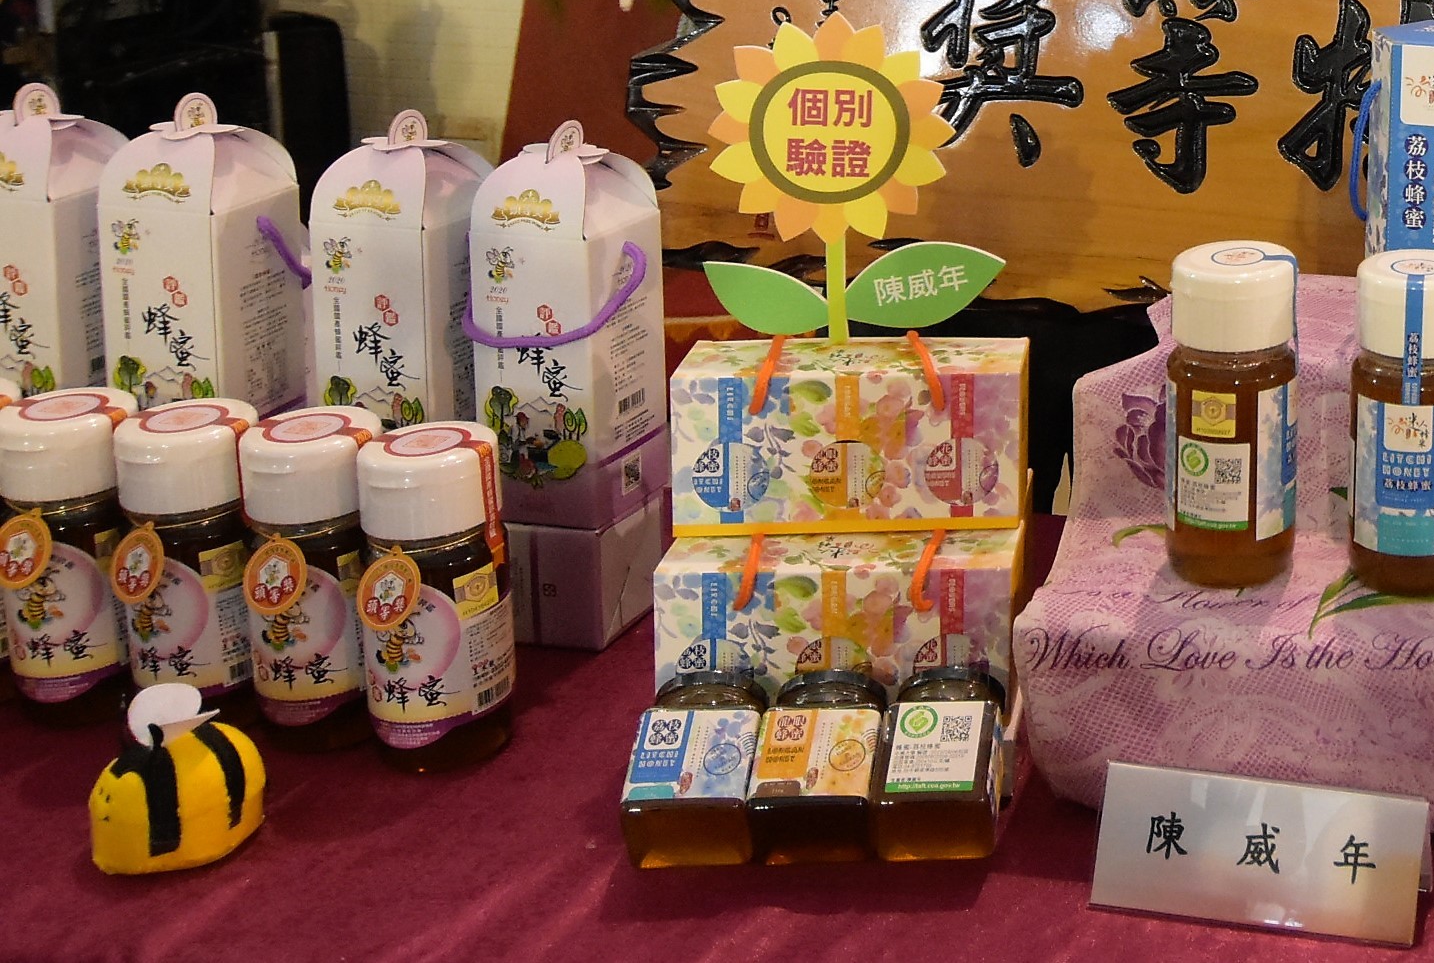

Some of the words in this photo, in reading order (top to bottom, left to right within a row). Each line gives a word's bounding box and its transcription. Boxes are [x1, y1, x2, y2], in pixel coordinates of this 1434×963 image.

[787, 88, 873, 128] 個別
[786, 138, 872, 178] 驗證
[1403, 133, 1429, 230] 荔枝蜂蜜
[873, 264, 969, 307] 陳威年
[141, 303, 210, 372] 蜂蜜
[352, 322, 420, 391] 蜂蜜
[1407, 332, 1420, 378] 荔枝蜂蜜
[516, 332, 584, 402] 蜂蜜
[1382, 452, 1432, 464] LITCHI
[1382, 465, 1430, 477] HONEY
[1384, 478, 1432, 491] 荔枝蜂蜜
[27, 630, 107, 667] 蜂蜜
[138, 645, 211, 681] 蜂蜜
[1025, 625, 1130, 672] Which
[1140, 626, 1236, 671] Love
[1246, 633, 1298, 671] Is
[1306, 640, 1354, 670] the
[270, 652, 348, 691] 蜂蜜
[384, 674, 461, 713] 蜂蜜
[638, 760, 676, 768] HONEY
[640, 751, 679, 759] LITCHI
